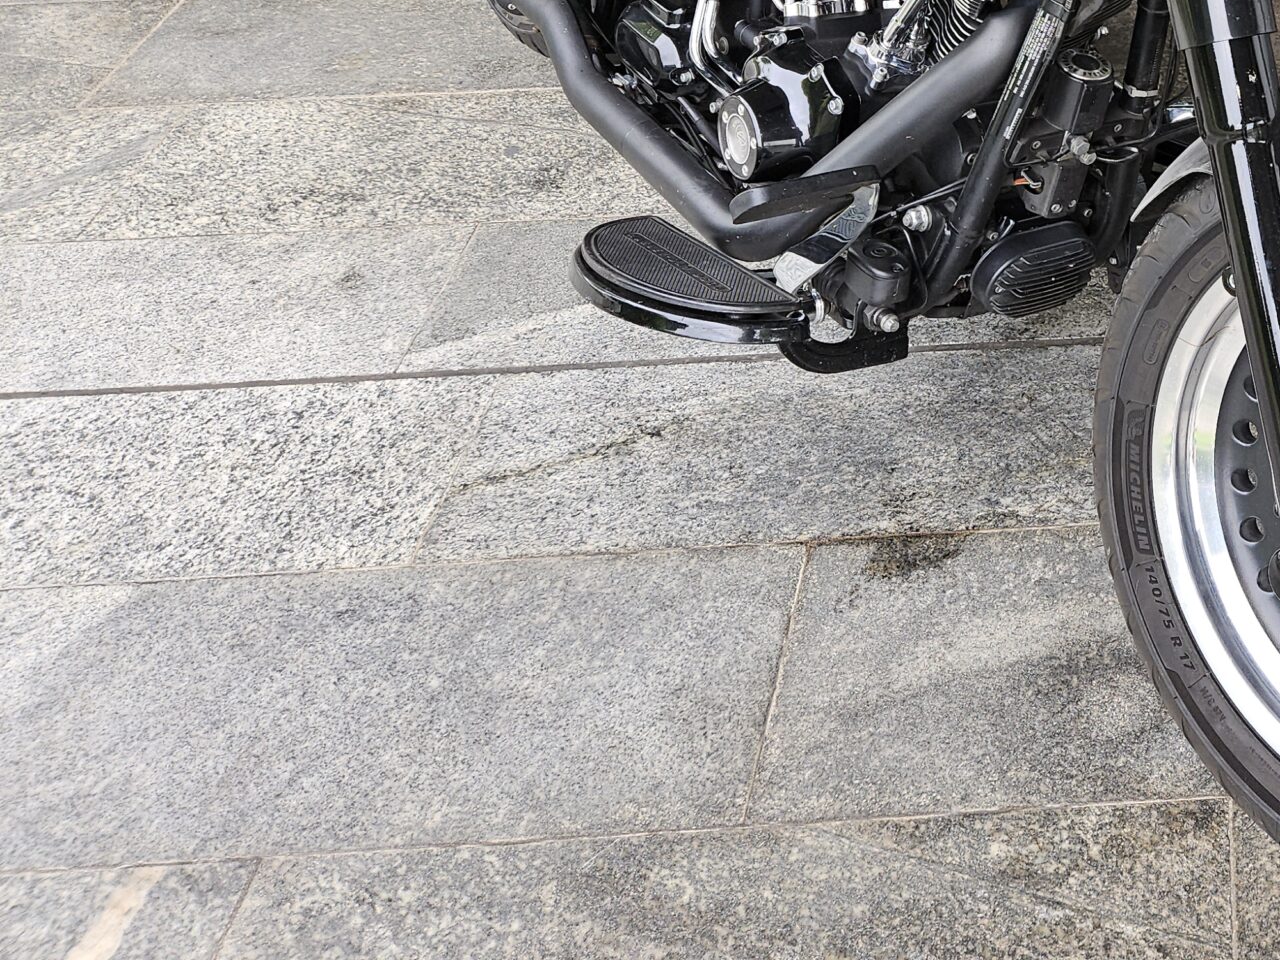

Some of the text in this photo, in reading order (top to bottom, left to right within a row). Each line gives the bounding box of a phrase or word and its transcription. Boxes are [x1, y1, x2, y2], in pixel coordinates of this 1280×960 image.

[1128, 442, 1151, 555] MICHELIN
[1145, 565, 1196, 672] 140/75 R 17
